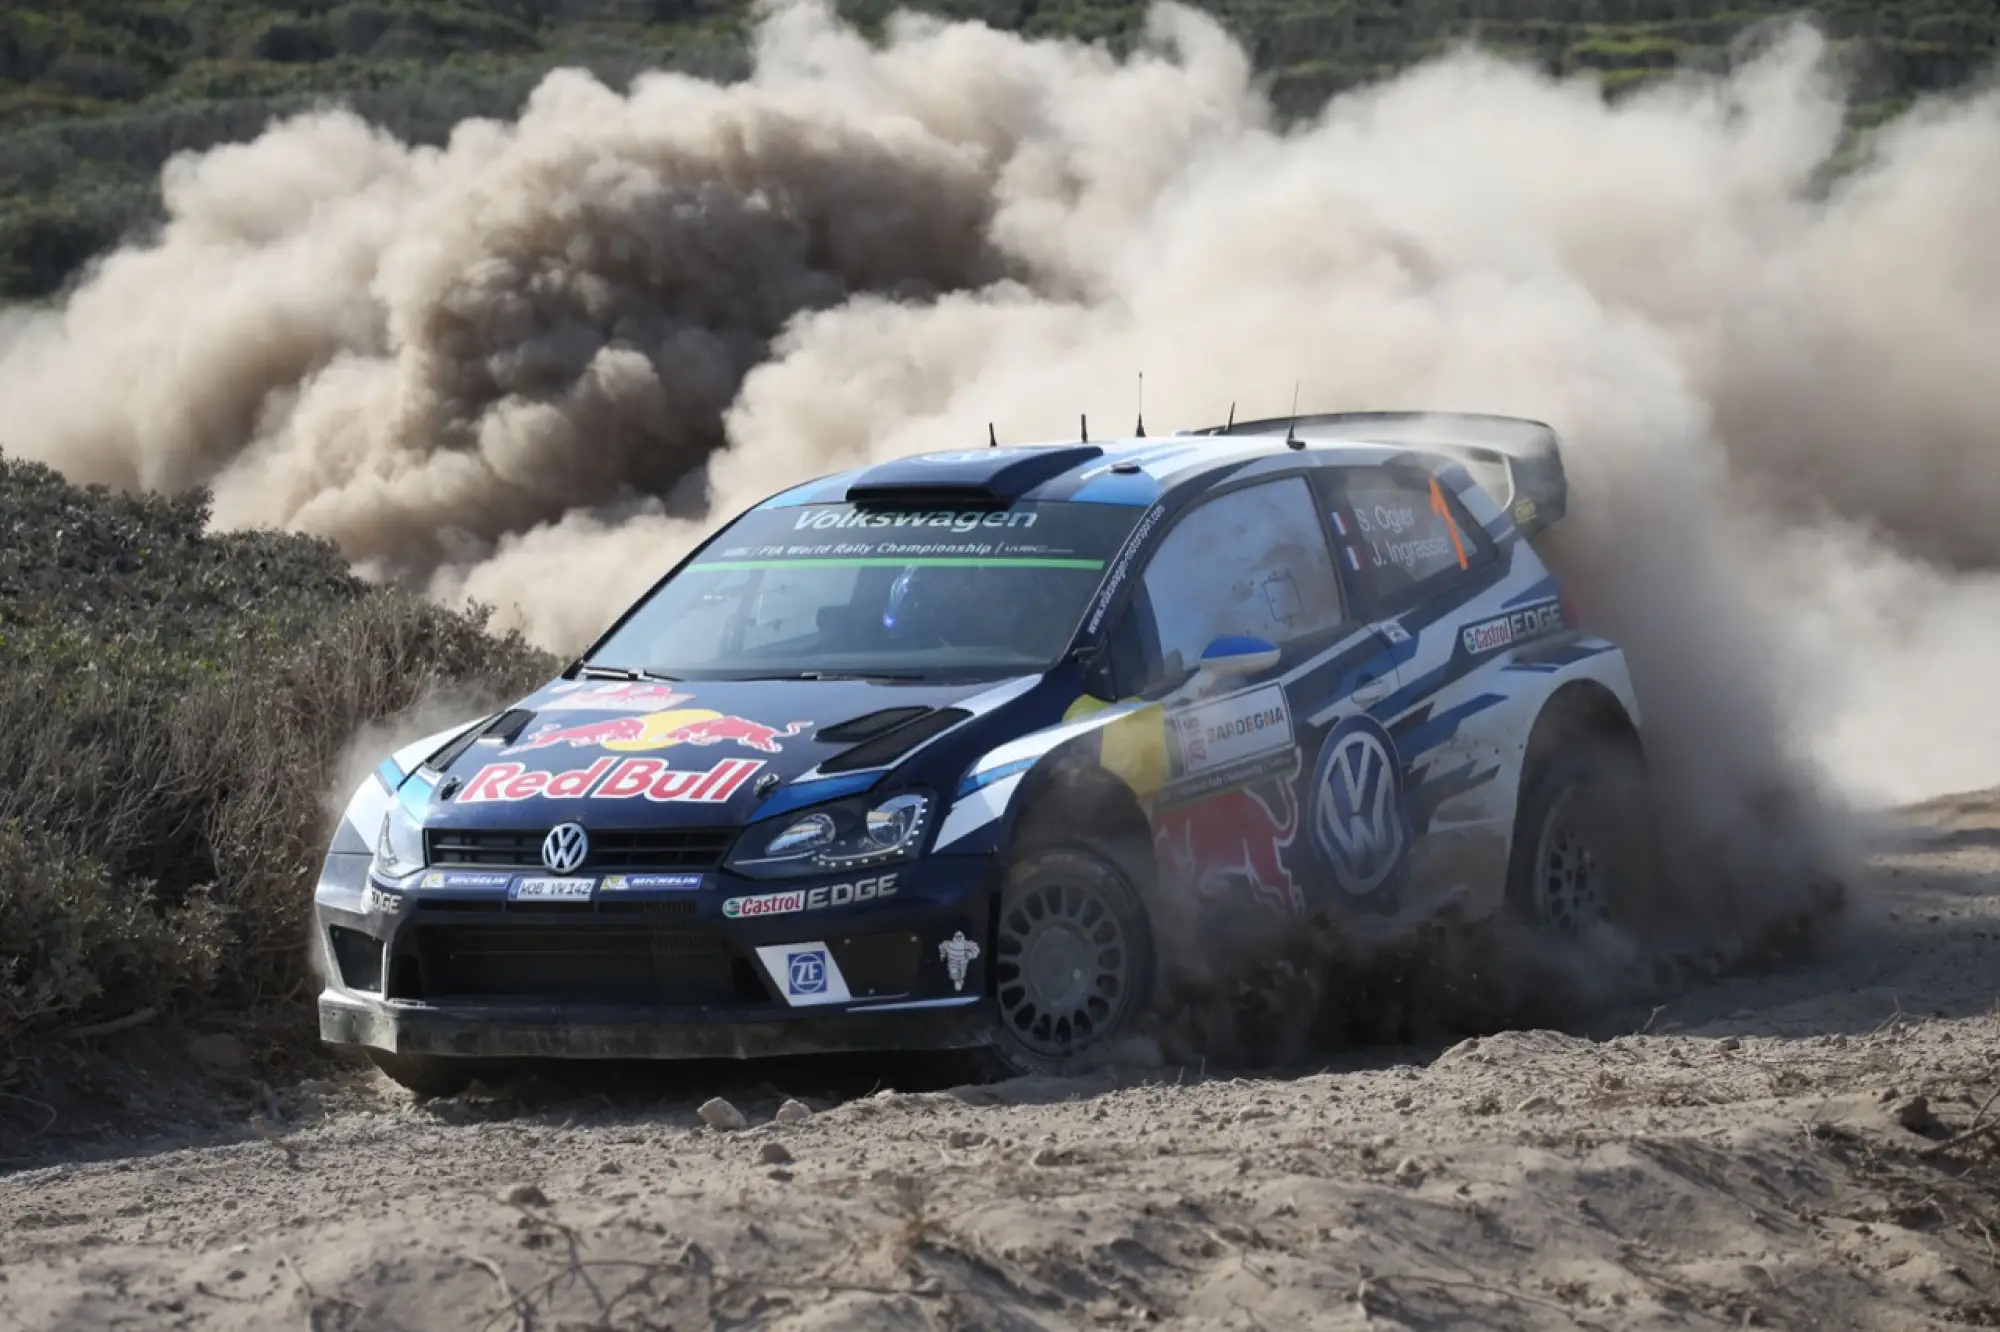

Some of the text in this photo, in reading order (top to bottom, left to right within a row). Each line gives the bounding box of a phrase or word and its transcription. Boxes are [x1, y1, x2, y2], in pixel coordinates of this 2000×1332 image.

[792, 508, 1038, 533] Volkswagen
[1428, 471, 1468, 570] 1
[788, 544, 834, 556] World
[837, 543, 872, 556] Rally
[877, 542, 992, 556] Championship
[1511, 603, 1564, 637] EDGE
[456, 756, 766, 802] Red Bull
[446, 874, 507, 886] MICHELIN
[630, 874, 700, 886] MICHELIN
[742, 873, 898, 917] Castrol EDGE
